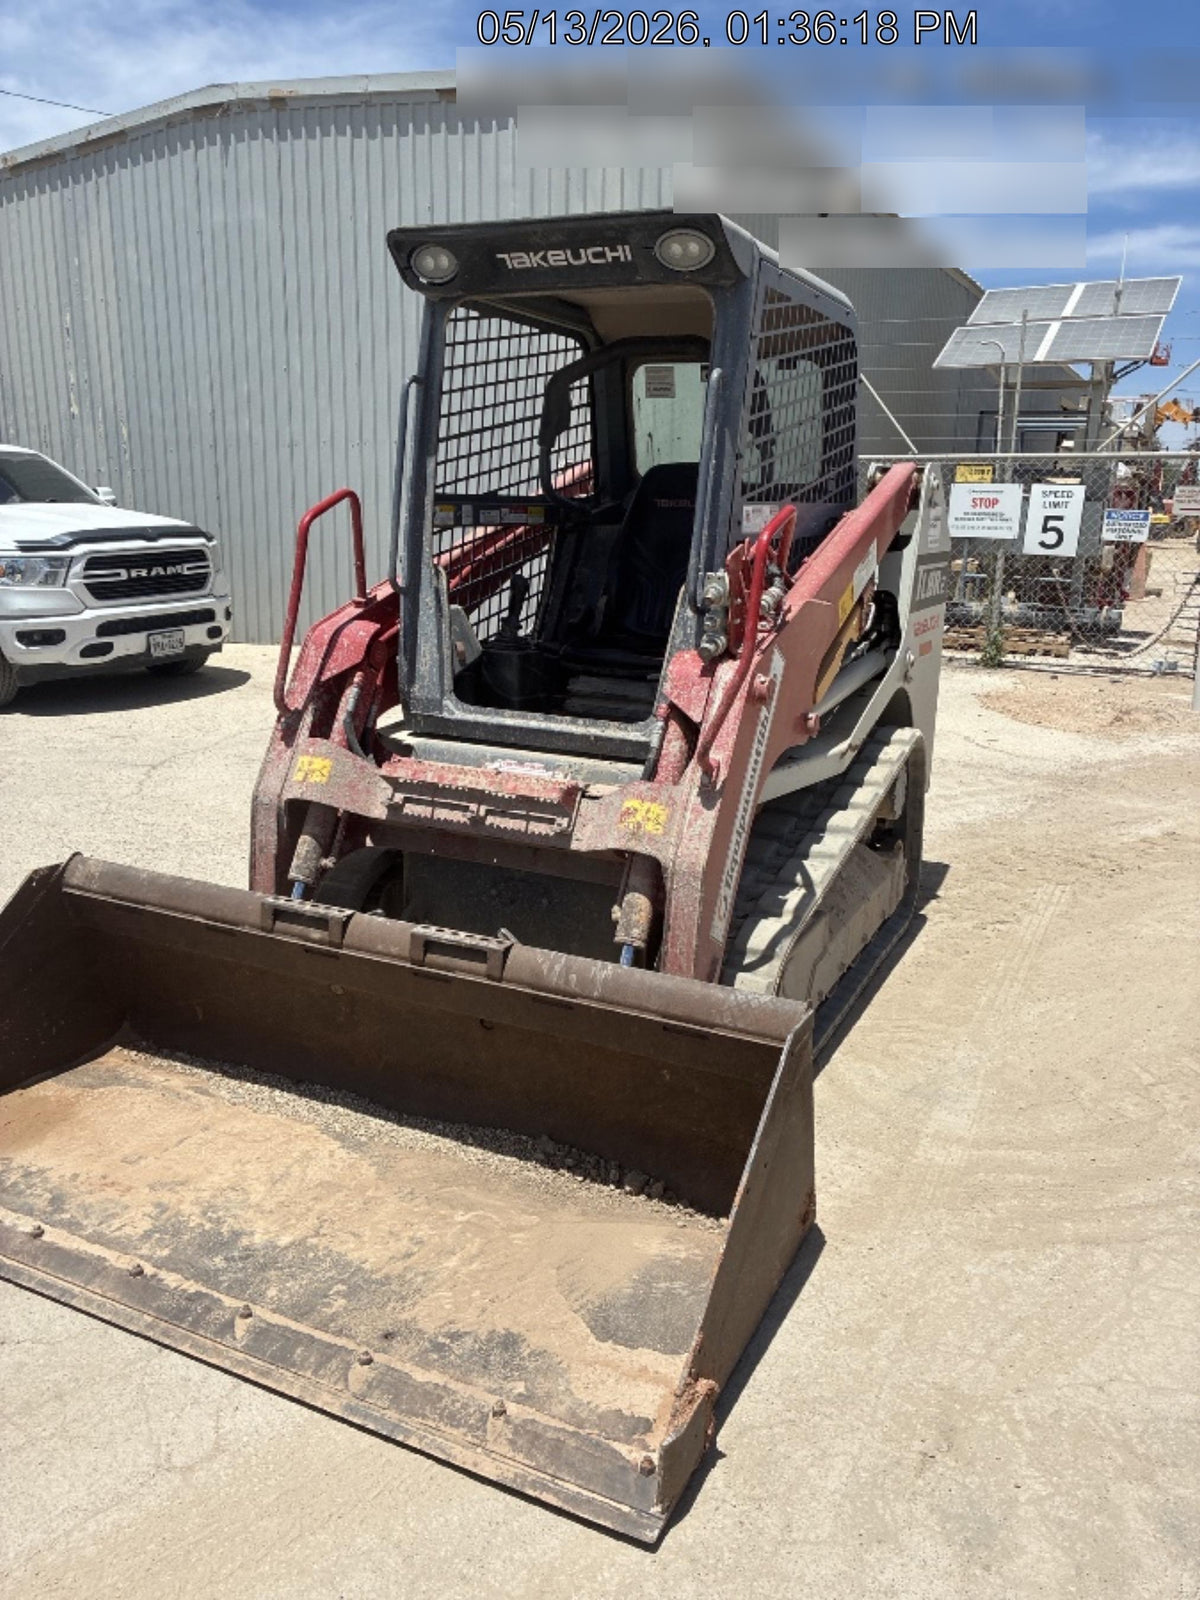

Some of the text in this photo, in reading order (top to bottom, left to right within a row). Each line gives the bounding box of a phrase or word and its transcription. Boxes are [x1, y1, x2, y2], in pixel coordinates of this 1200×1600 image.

[1041, 490, 1075, 500] SPEED
[971, 497, 1000, 510] STOP
[1042, 501, 1071, 510] LIMIT
[1038, 515, 1065, 550] 5
[129, 564, 183, 579] RAM
